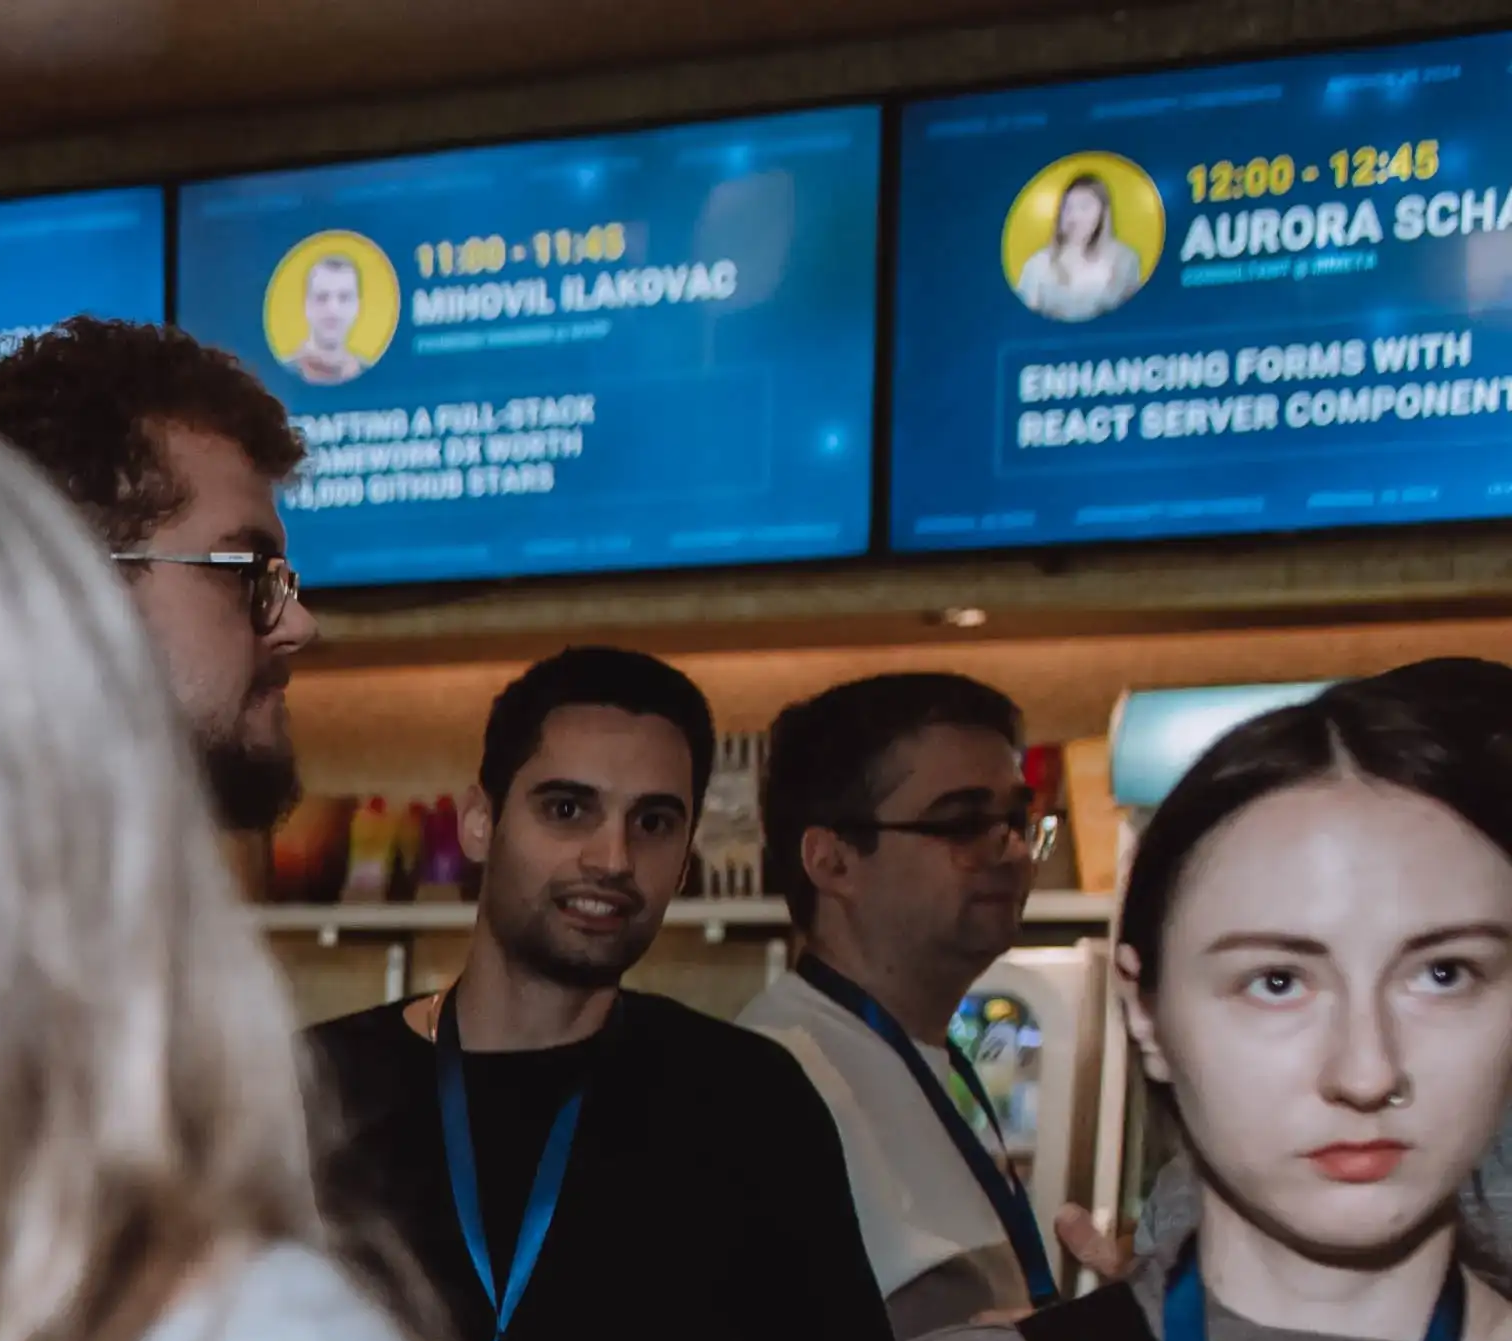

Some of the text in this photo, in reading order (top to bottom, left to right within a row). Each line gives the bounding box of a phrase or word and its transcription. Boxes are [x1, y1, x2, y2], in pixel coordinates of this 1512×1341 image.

[1187, 154, 1294, 203] 12:00
[1329, 140, 1440, 188] 12:45
[415, 234, 506, 279] 11:00
[532, 222, 625, 267] 11:45
[1181, 199, 1384, 261] AURORA
[411, 259, 738, 327] MIHOVIL ILAKOVAC
[1017, 329, 1472, 402] ENHANCING FORMS WITH
[1017, 405, 1135, 449] REACT
[1140, 393, 1279, 439] SERVER
